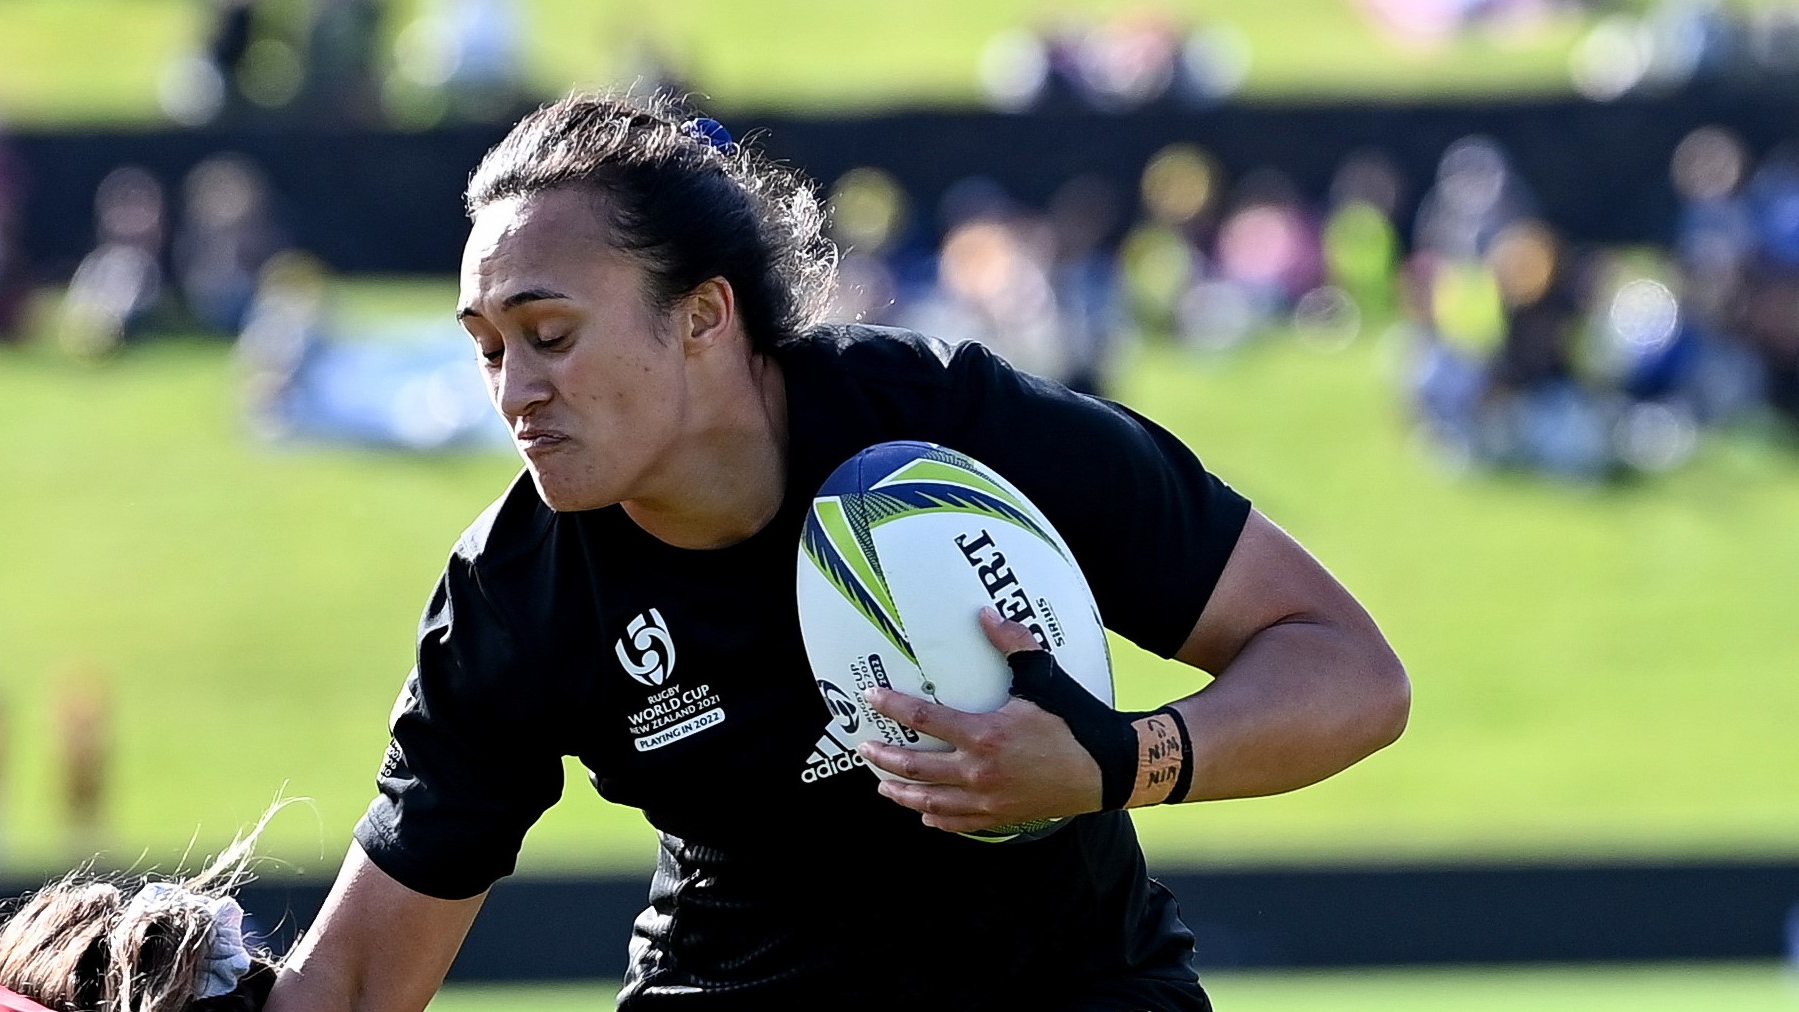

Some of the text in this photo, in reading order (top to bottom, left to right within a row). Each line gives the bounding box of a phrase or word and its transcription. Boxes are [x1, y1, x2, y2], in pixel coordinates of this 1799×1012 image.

[850, 663, 867, 691] CUP
[871, 660, 889, 687] 2022
[628, 684, 710, 725] WORLD CUP
[647, 684, 680, 704] RUGBY
[629, 694, 721, 734] NEW ZEALAND 2021
[639, 712, 720, 749] PLAYING IN 2022
